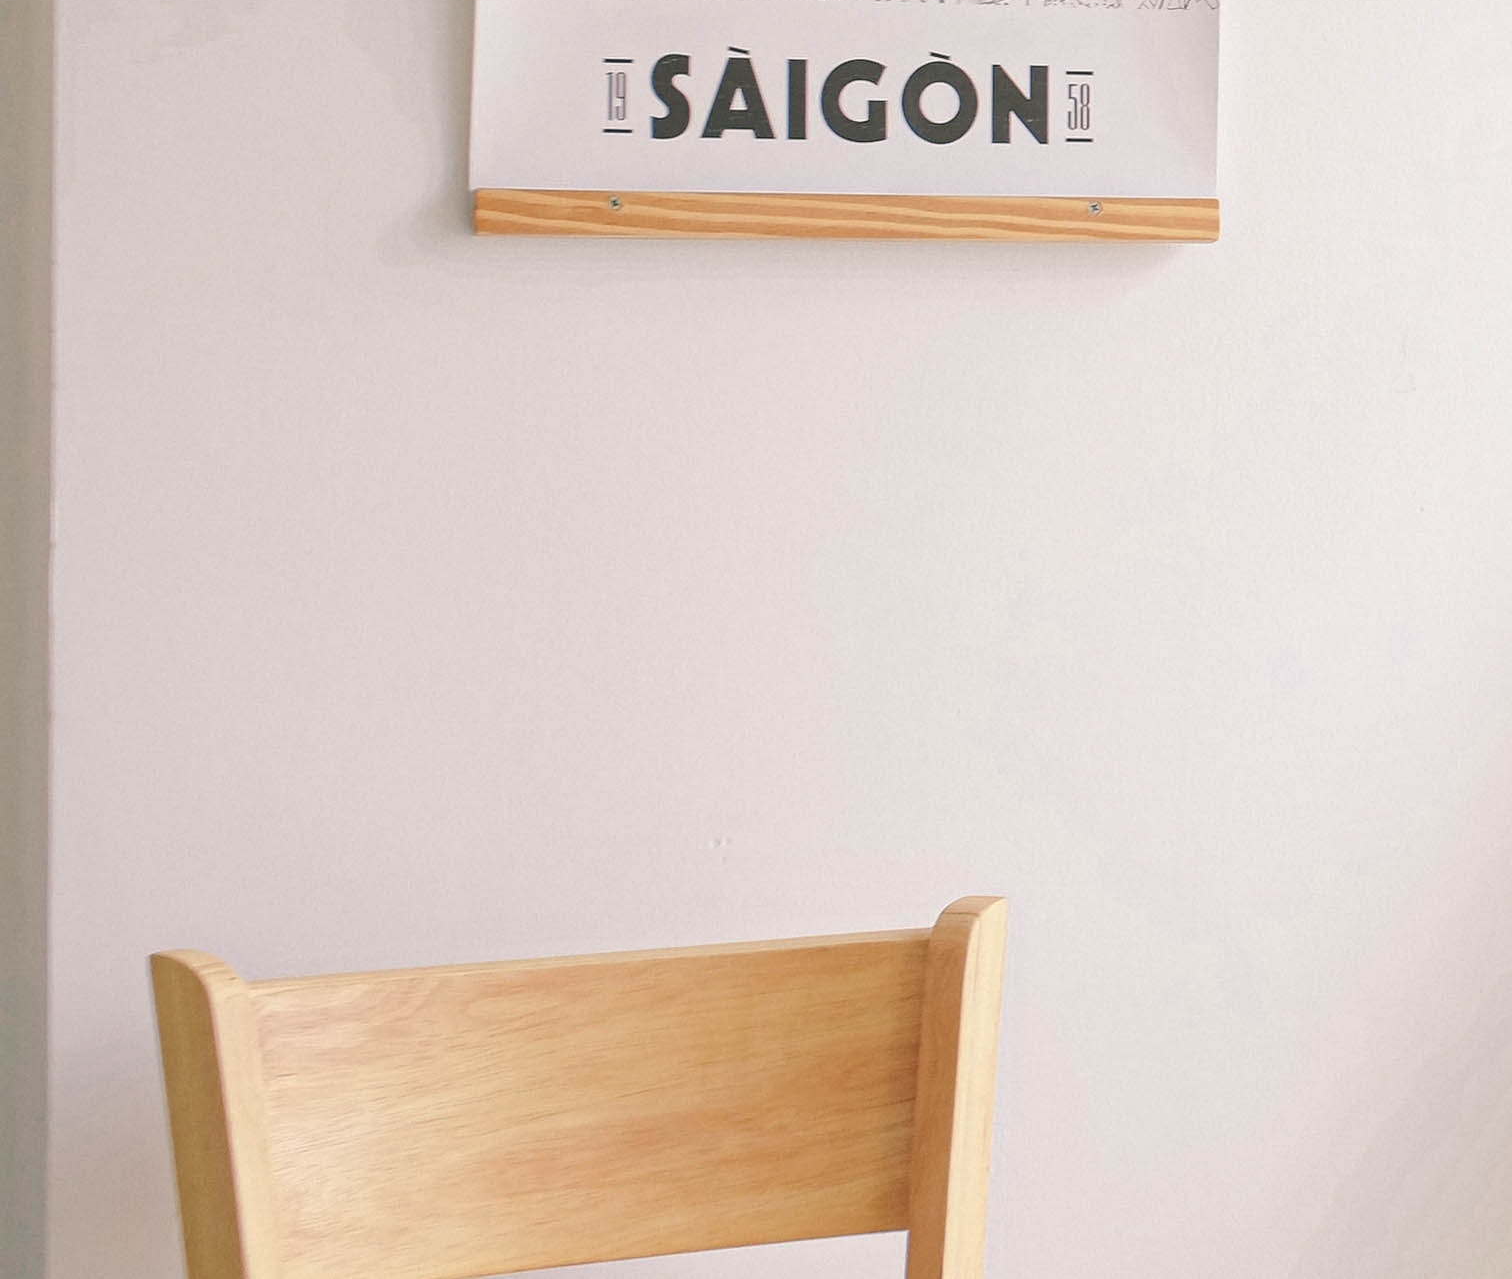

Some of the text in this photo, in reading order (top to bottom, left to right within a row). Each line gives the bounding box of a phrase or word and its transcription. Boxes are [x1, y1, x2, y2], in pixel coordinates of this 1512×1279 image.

[605, 46, 1091, 145] 19 SÀIGÒN 58
